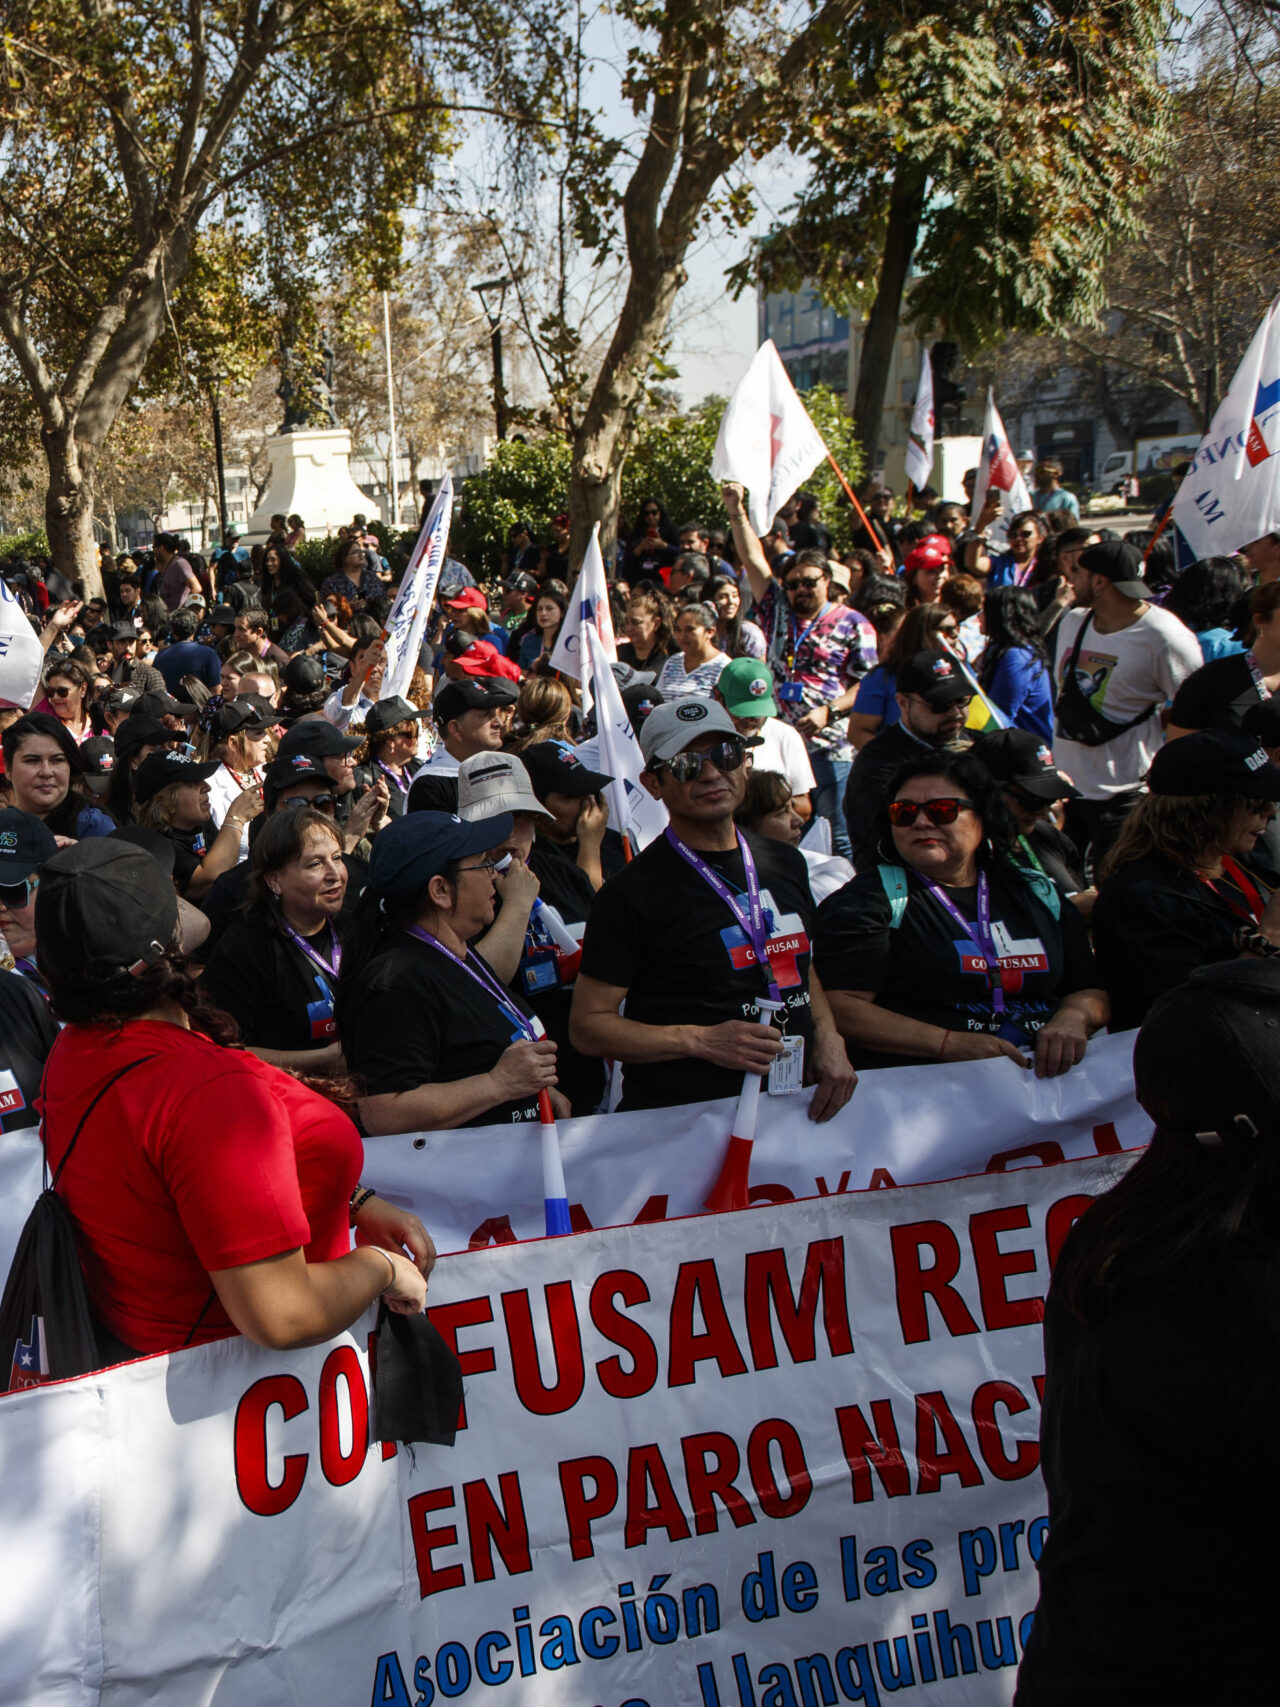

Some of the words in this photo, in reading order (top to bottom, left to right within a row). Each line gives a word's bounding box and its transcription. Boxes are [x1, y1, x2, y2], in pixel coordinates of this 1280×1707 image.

[972, 957, 1040, 969] COFUSAM
[234, 1236, 855, 1517] COFUSAM
[407, 1471, 533, 1600] EN
[558, 1417, 814, 1562] PARO
[835, 1375, 1046, 1504] NAC
[370, 1573, 721, 1707] Asociación
[741, 1550, 819, 1623] de
[839, 1535, 938, 1602] las
